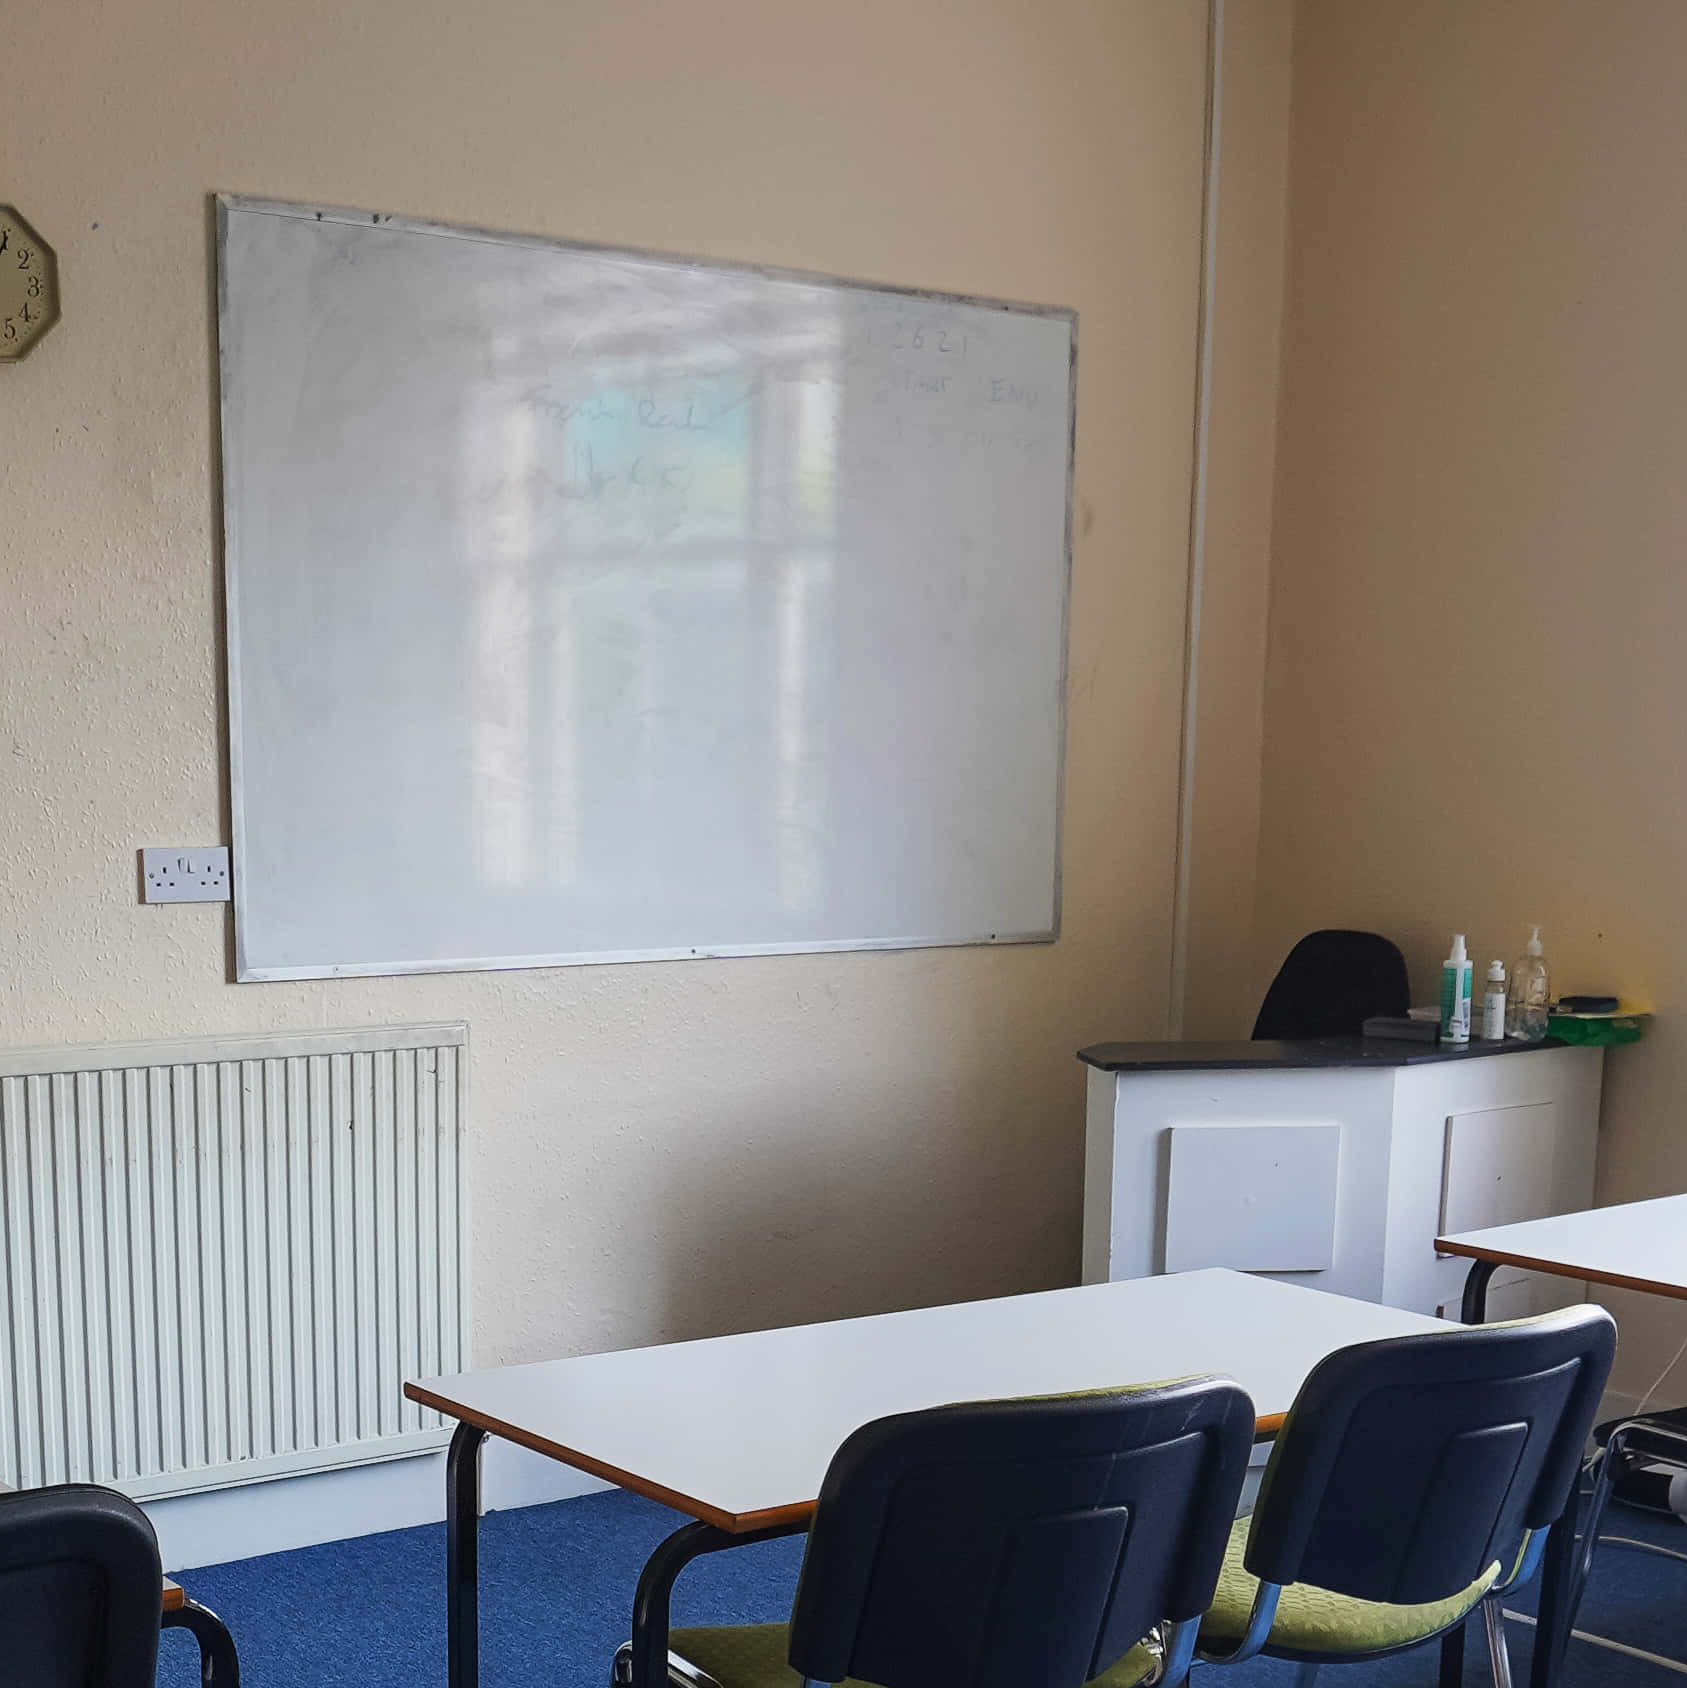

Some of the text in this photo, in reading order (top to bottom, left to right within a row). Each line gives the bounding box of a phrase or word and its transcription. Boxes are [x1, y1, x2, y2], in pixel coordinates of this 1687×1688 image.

[17, 250, 30, 269] 2
[27, 276, 39, 297] 3
[18, 302, 31, 322] 4
[4, 318, 16, 339] 5
